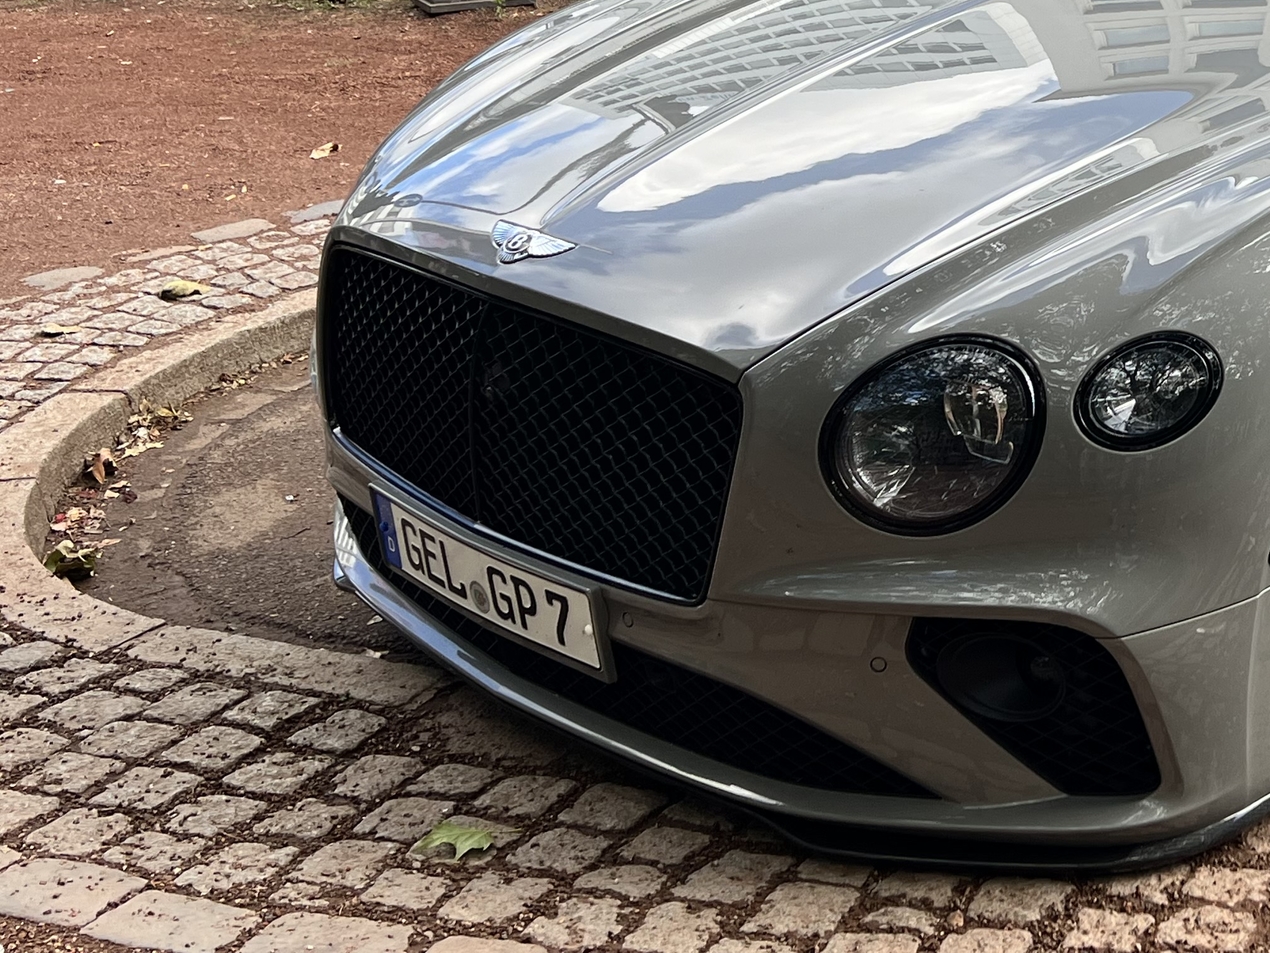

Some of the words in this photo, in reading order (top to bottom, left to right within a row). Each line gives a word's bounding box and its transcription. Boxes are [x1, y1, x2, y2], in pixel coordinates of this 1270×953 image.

[387, 535, 396, 553] D
[401, 517, 468, 600] GEL
[486, 565, 537, 631] GP
[544, 588, 570, 647] 7
